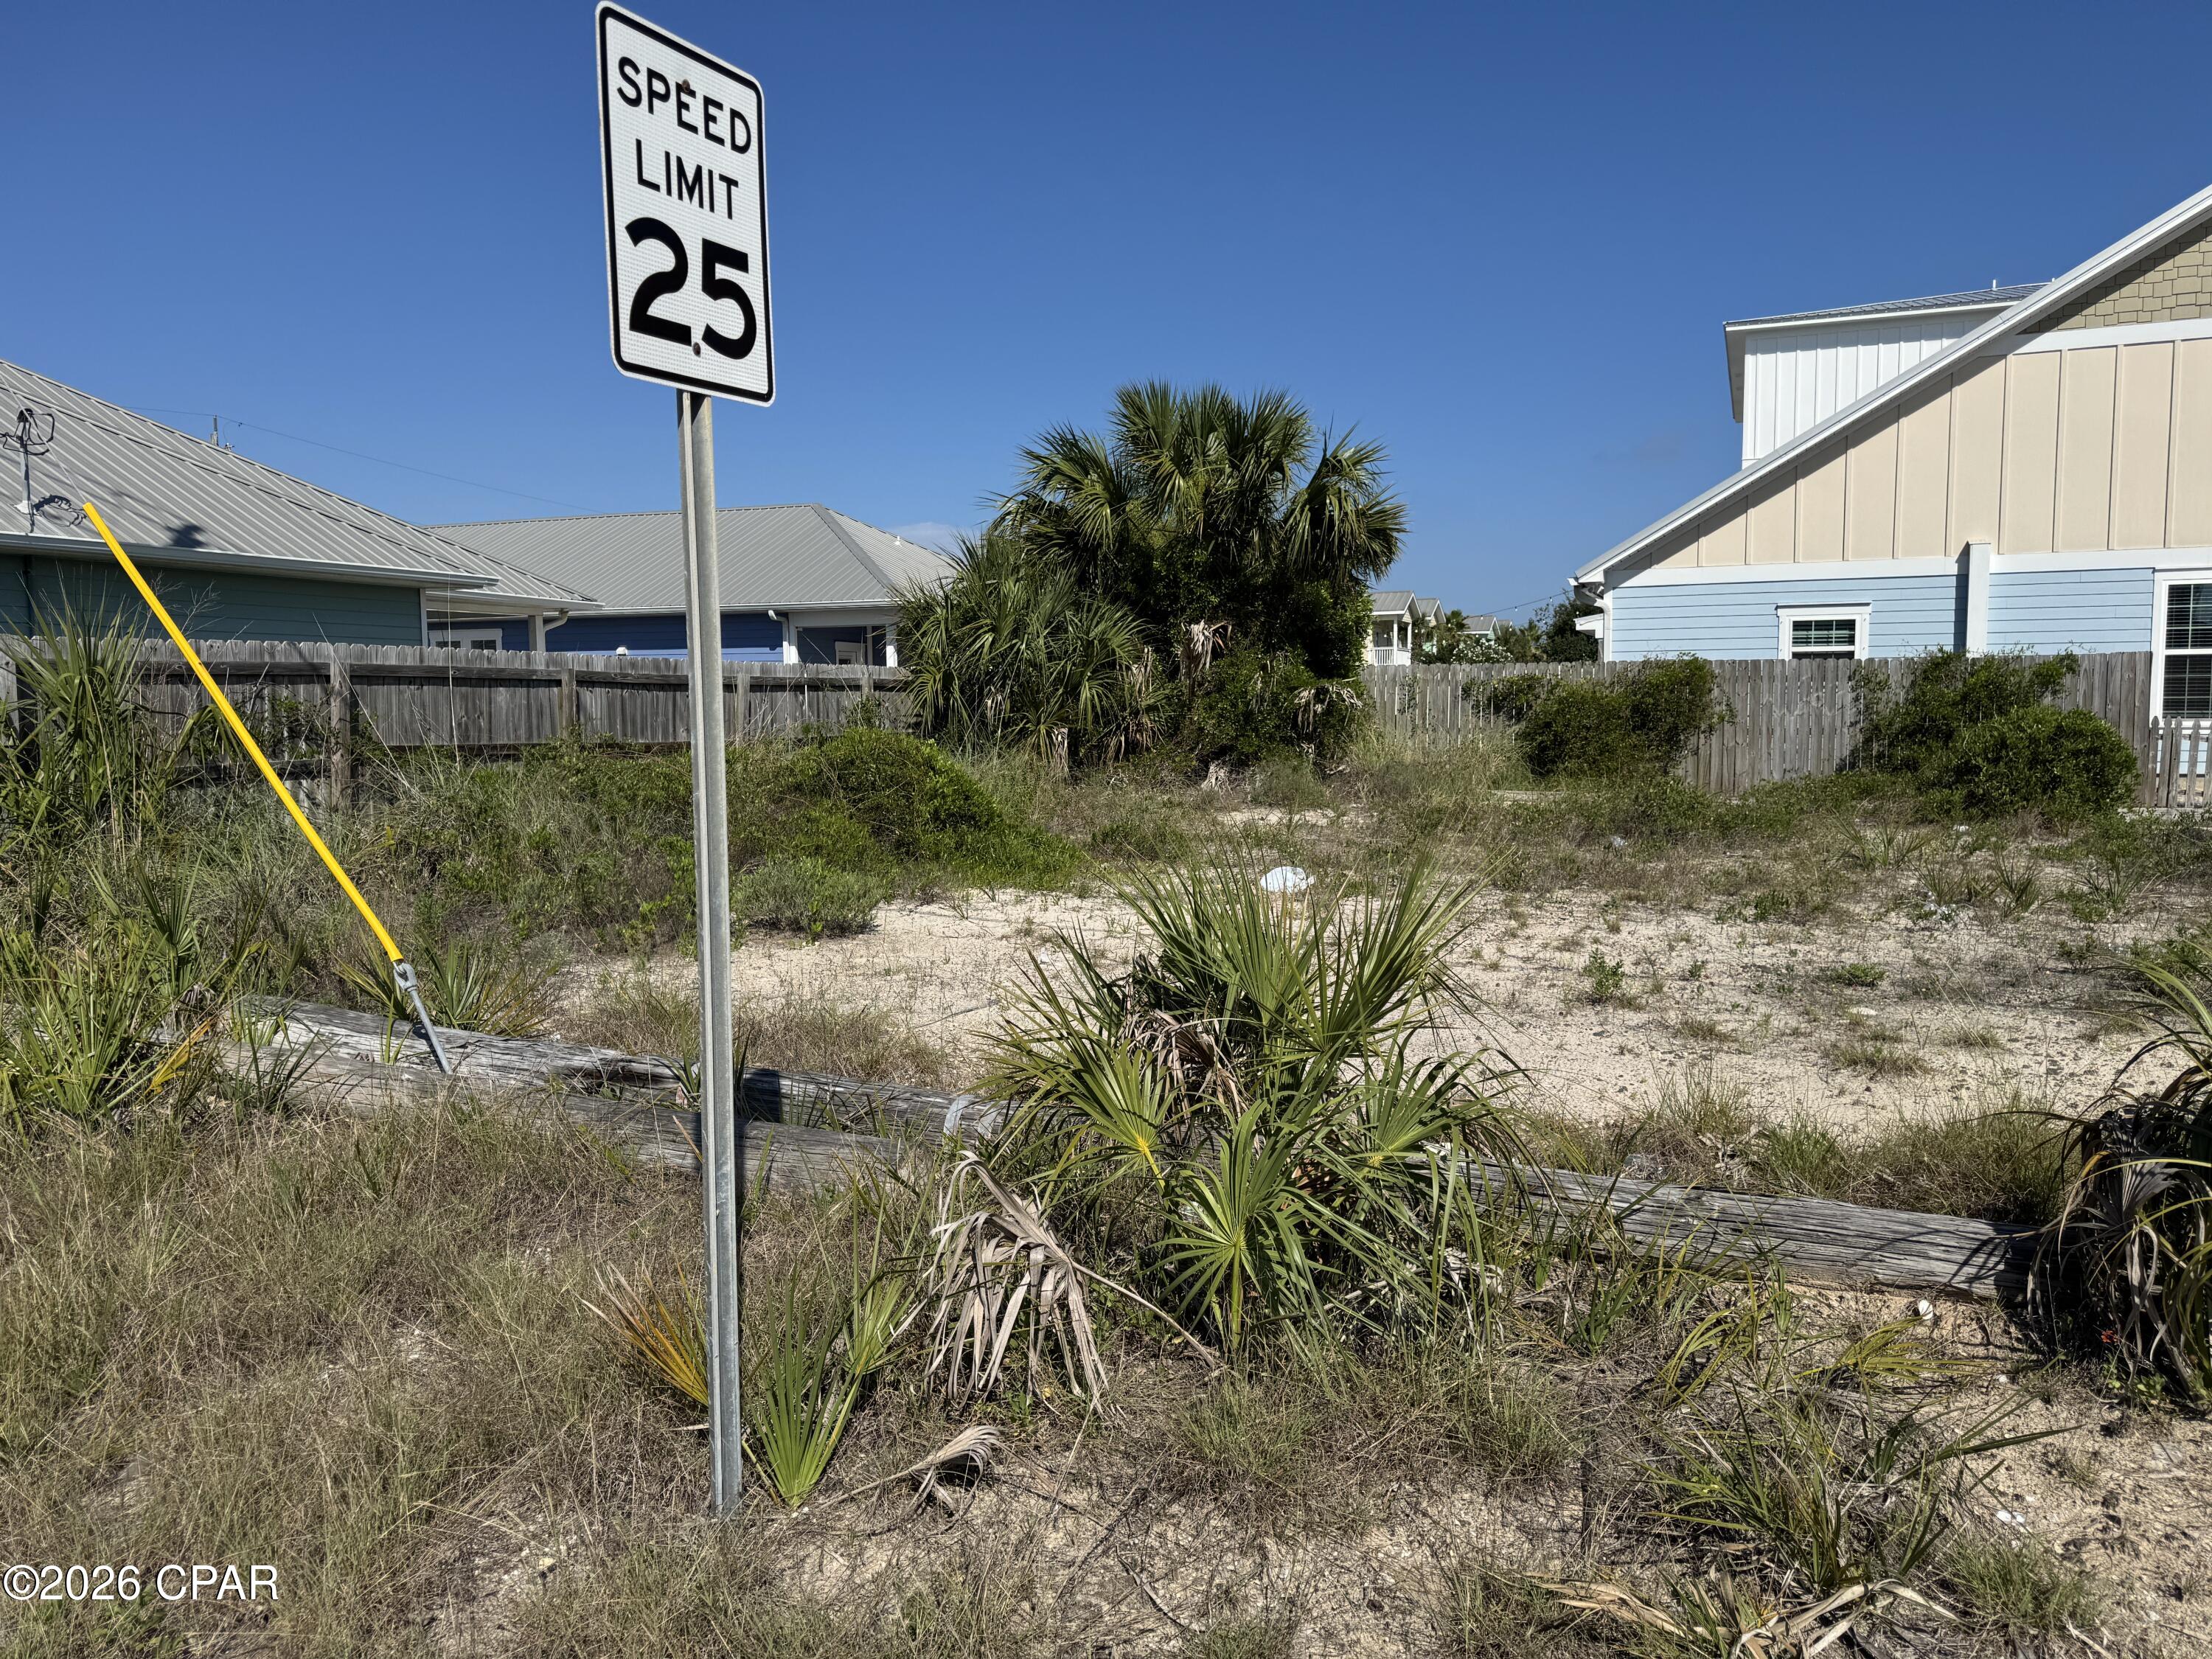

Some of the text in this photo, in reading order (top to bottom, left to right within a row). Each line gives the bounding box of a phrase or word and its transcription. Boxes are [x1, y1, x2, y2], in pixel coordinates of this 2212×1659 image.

[617, 56, 752, 155] SPEED
[636, 138, 739, 220] LIMIT
[625, 217, 757, 360] 25
